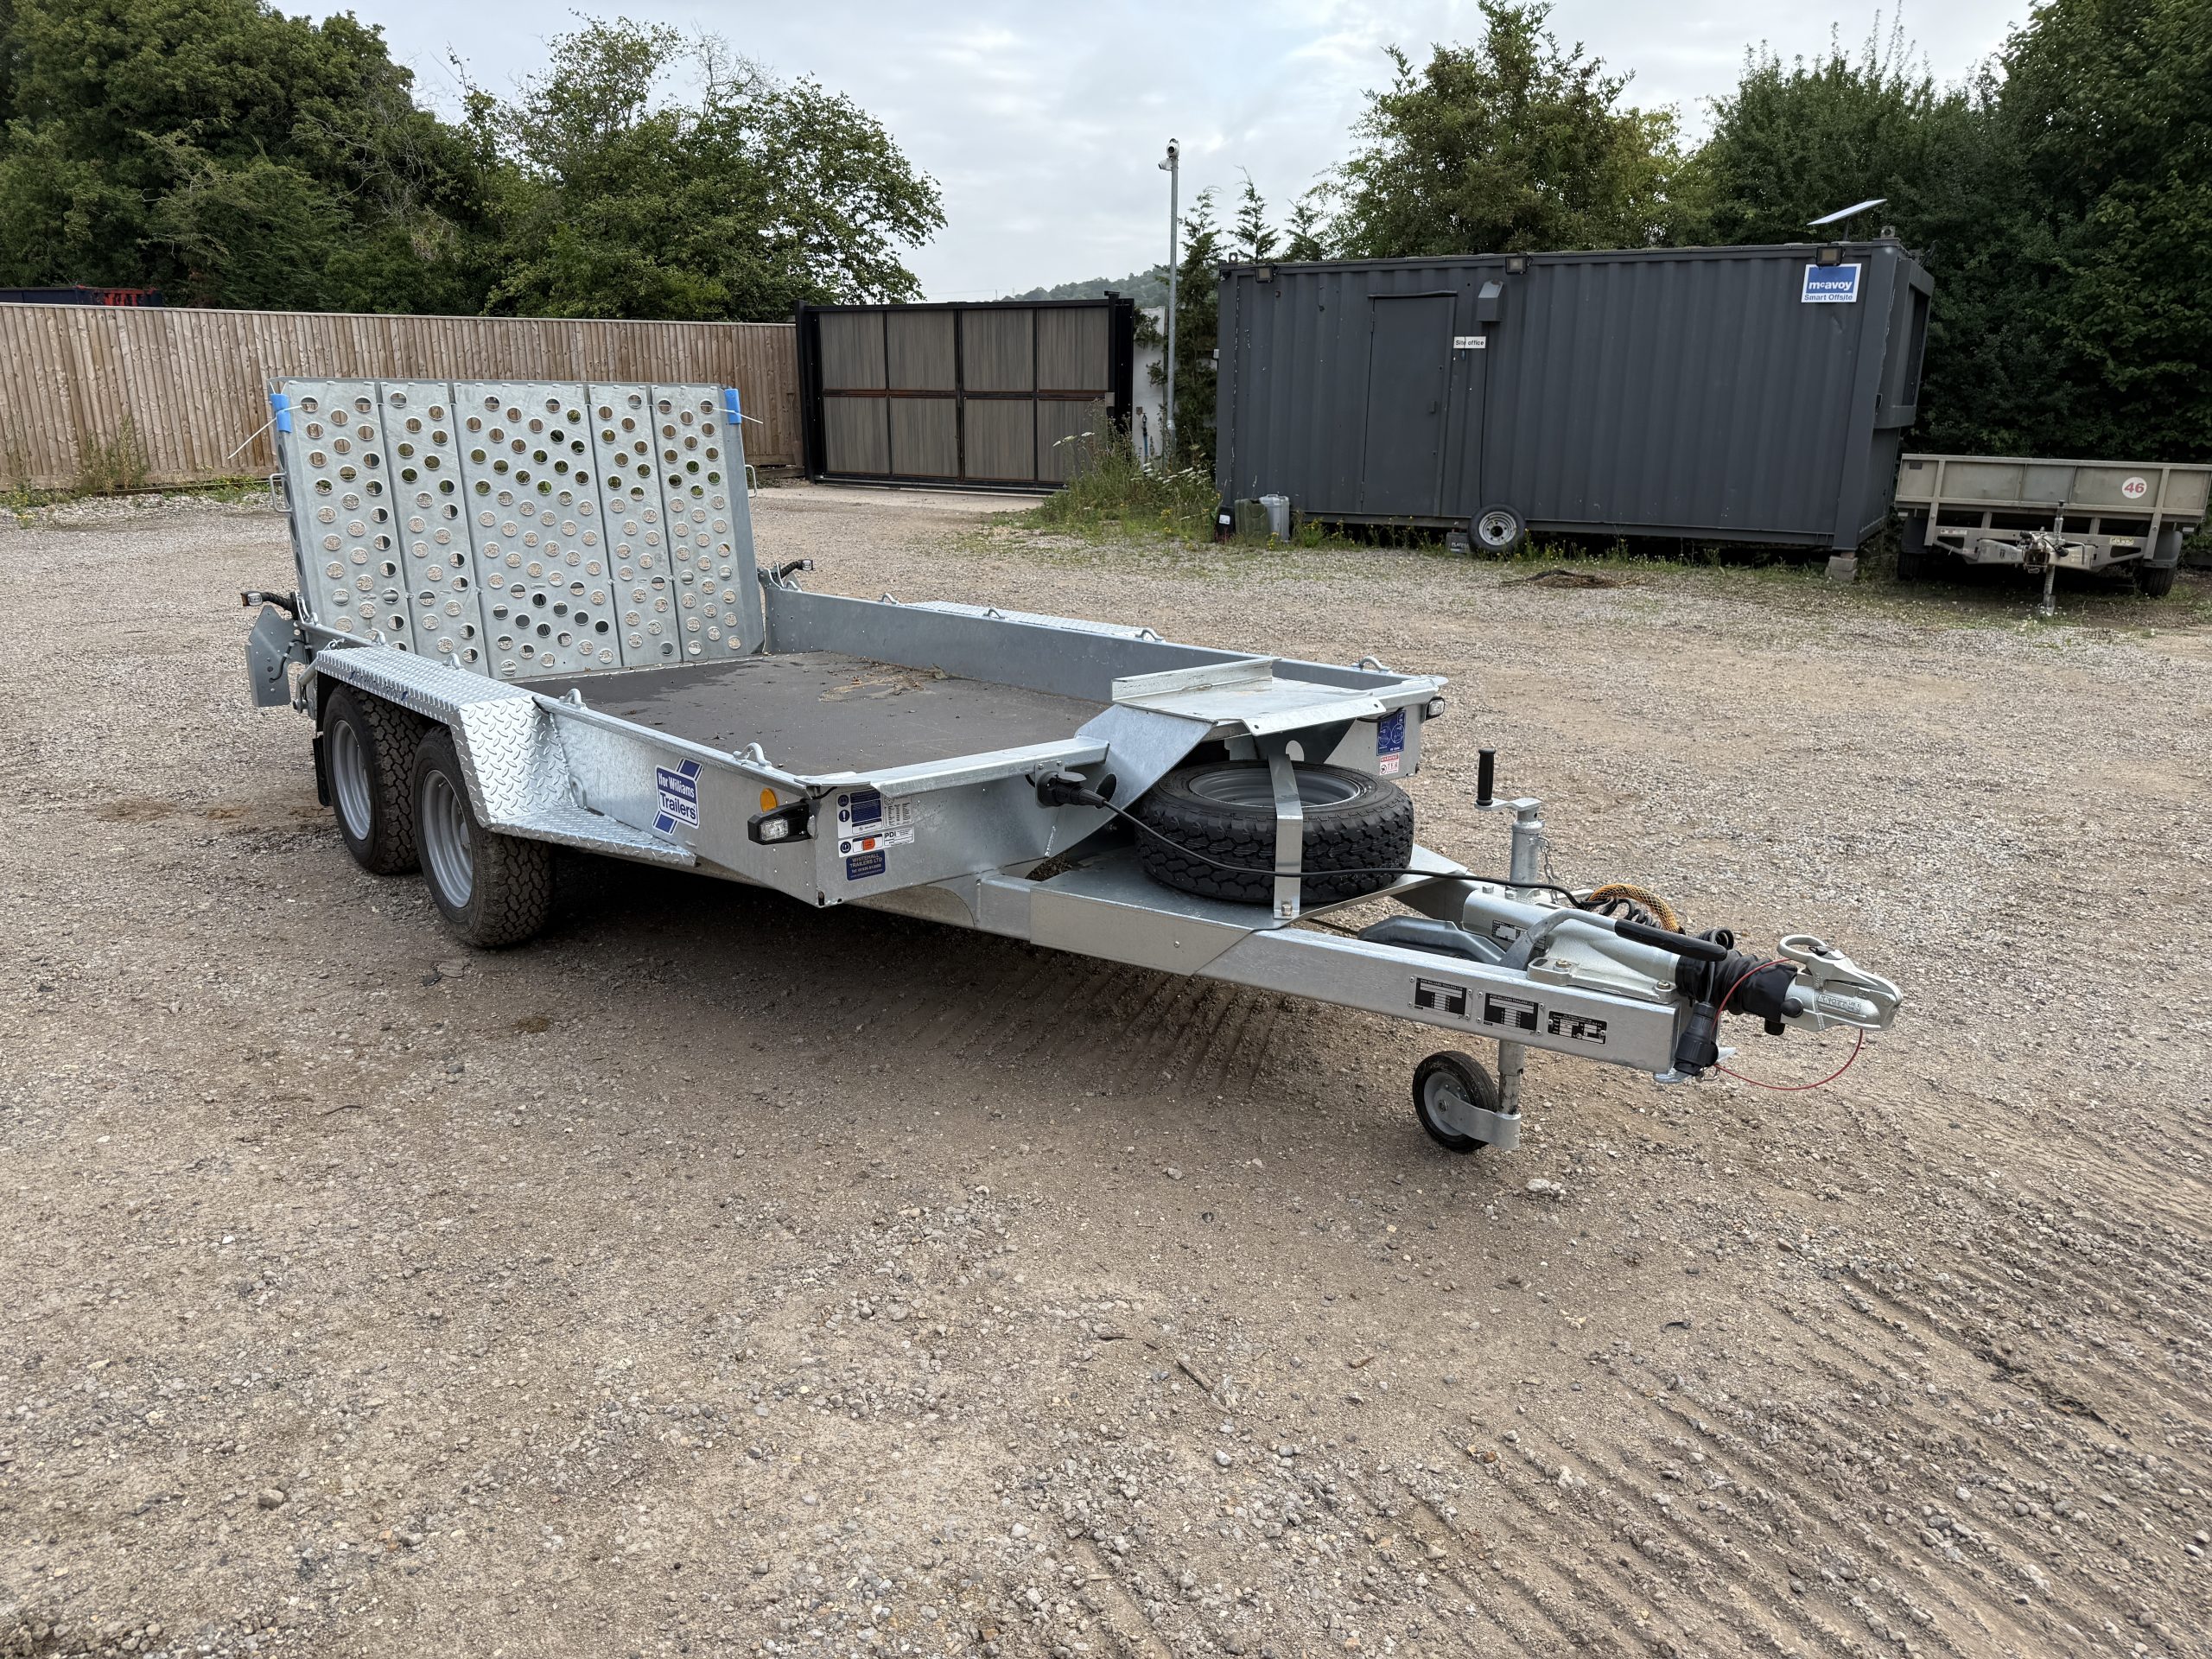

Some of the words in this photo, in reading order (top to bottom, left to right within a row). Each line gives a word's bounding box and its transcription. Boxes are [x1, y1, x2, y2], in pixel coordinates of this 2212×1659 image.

[2124, 482, 2145, 493] 46
[669, 777, 695, 798] Williams
[659, 791, 696, 820] Trailers
[852, 854, 880, 862] WHITEHALL
